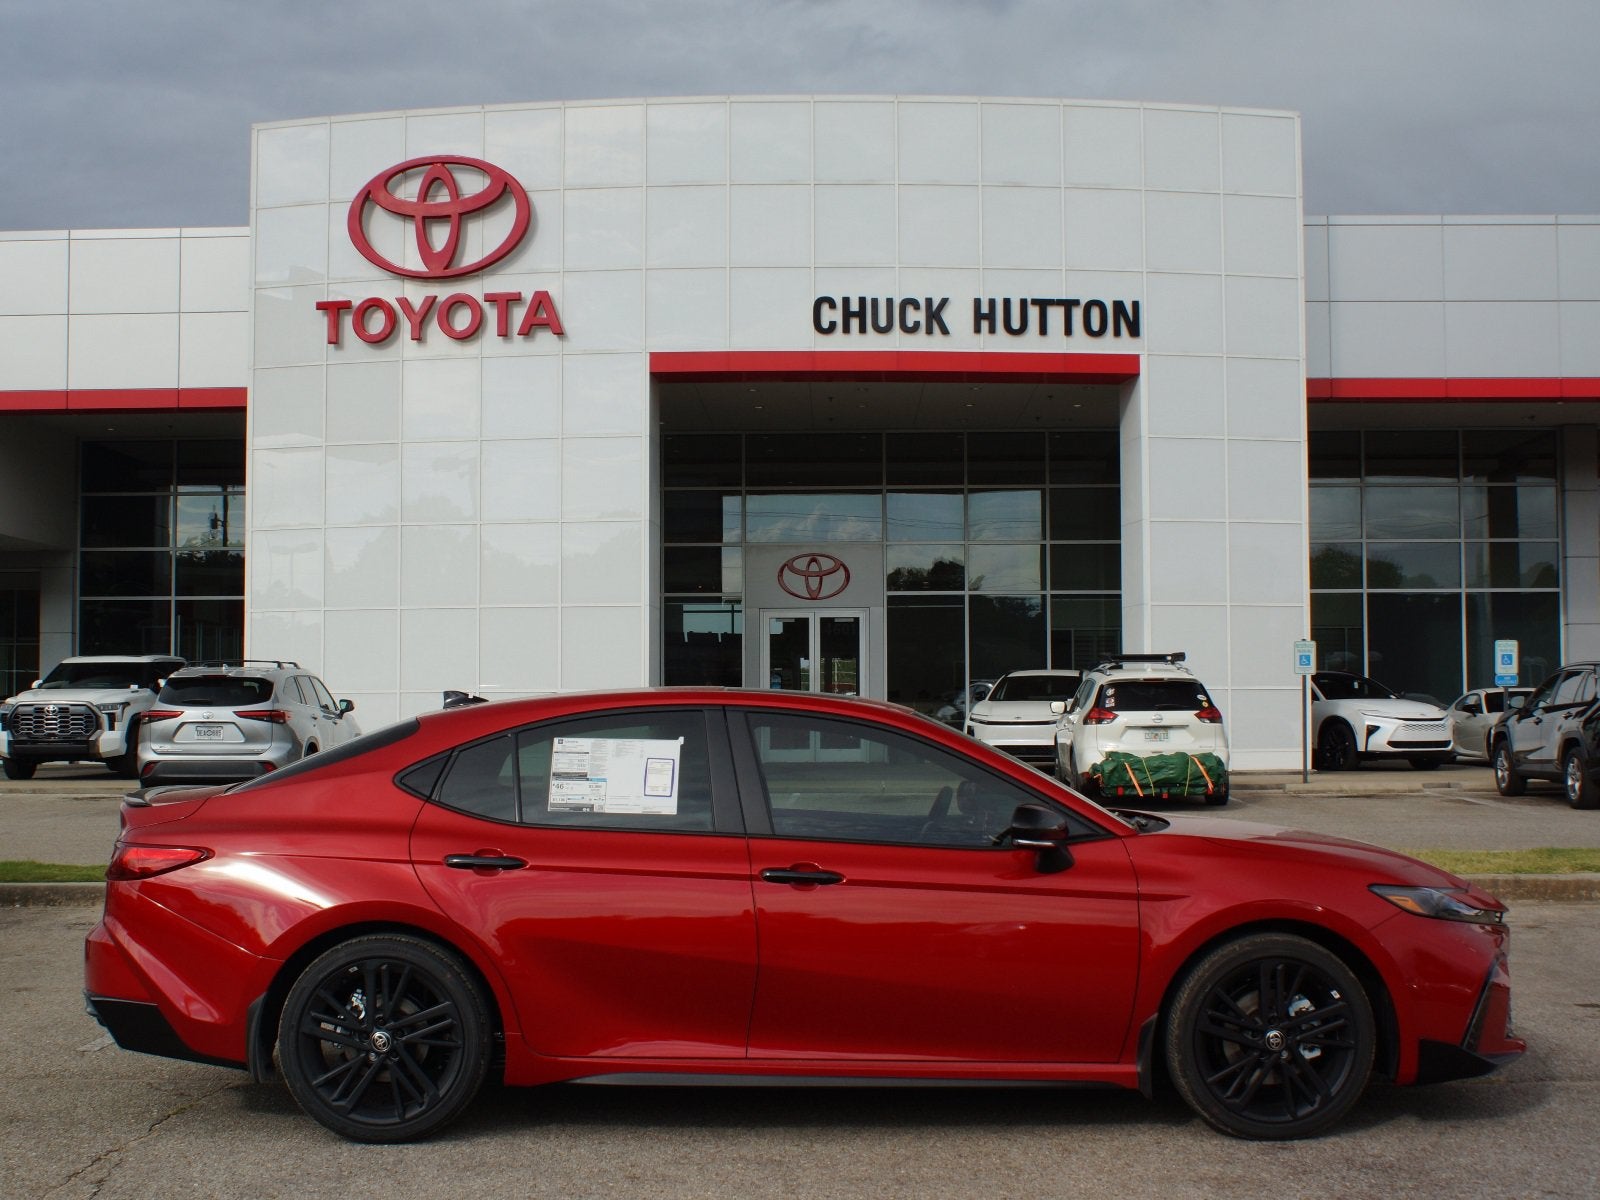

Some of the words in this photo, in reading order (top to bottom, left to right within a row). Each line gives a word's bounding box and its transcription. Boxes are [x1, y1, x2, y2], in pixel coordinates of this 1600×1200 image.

[316, 290, 564, 344] TOYOTA
[812, 296, 950, 334] CHUCK
[973, 297, 1141, 337] HUTTON
